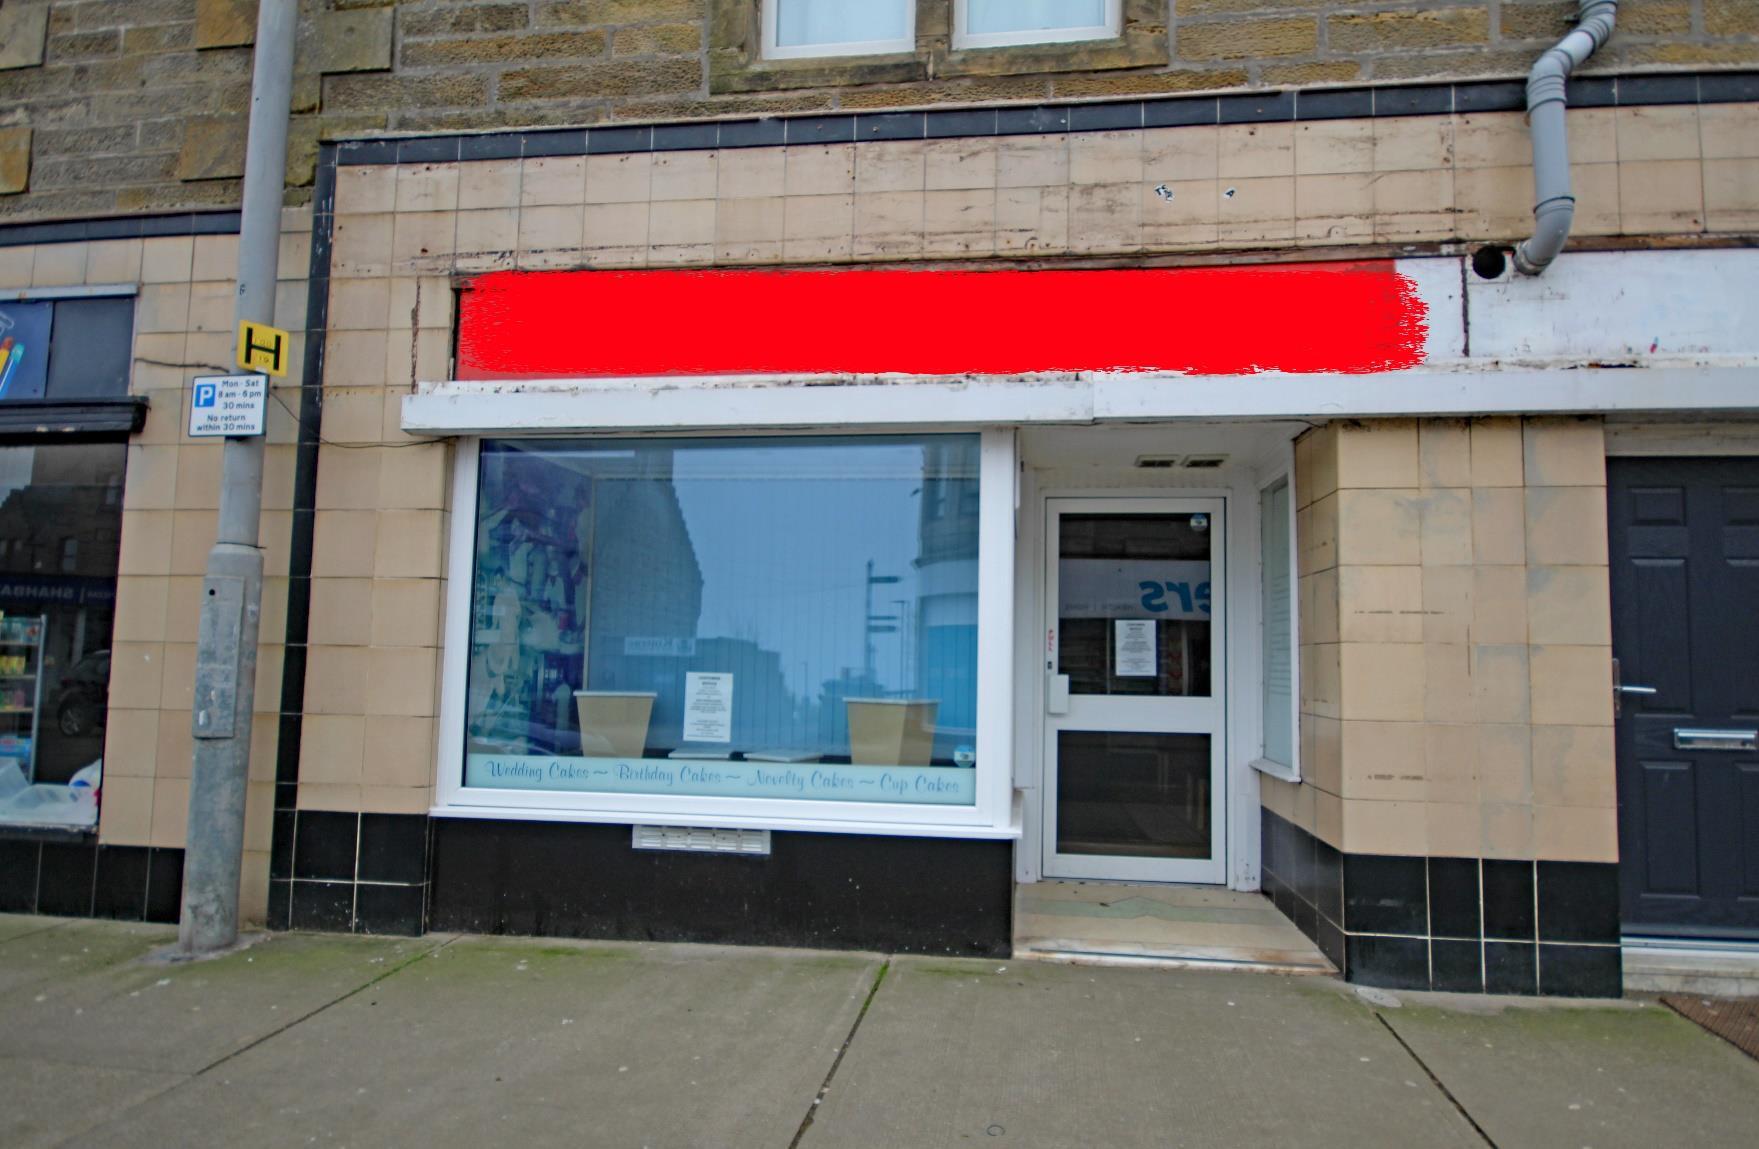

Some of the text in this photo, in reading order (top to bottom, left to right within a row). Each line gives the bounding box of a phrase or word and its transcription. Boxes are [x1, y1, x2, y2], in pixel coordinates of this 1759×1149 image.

[244, 327, 281, 371] H
[245, 379, 259, 387] Sat
[199, 387, 213, 407] P
[250, 391, 262, 399] pm
[220, 414, 246, 422] return
[237, 423, 255, 431] mins
[488, 761, 959, 795] Wedding Cakes Birthday Cakes Novelty Cakes Cup Cakes
